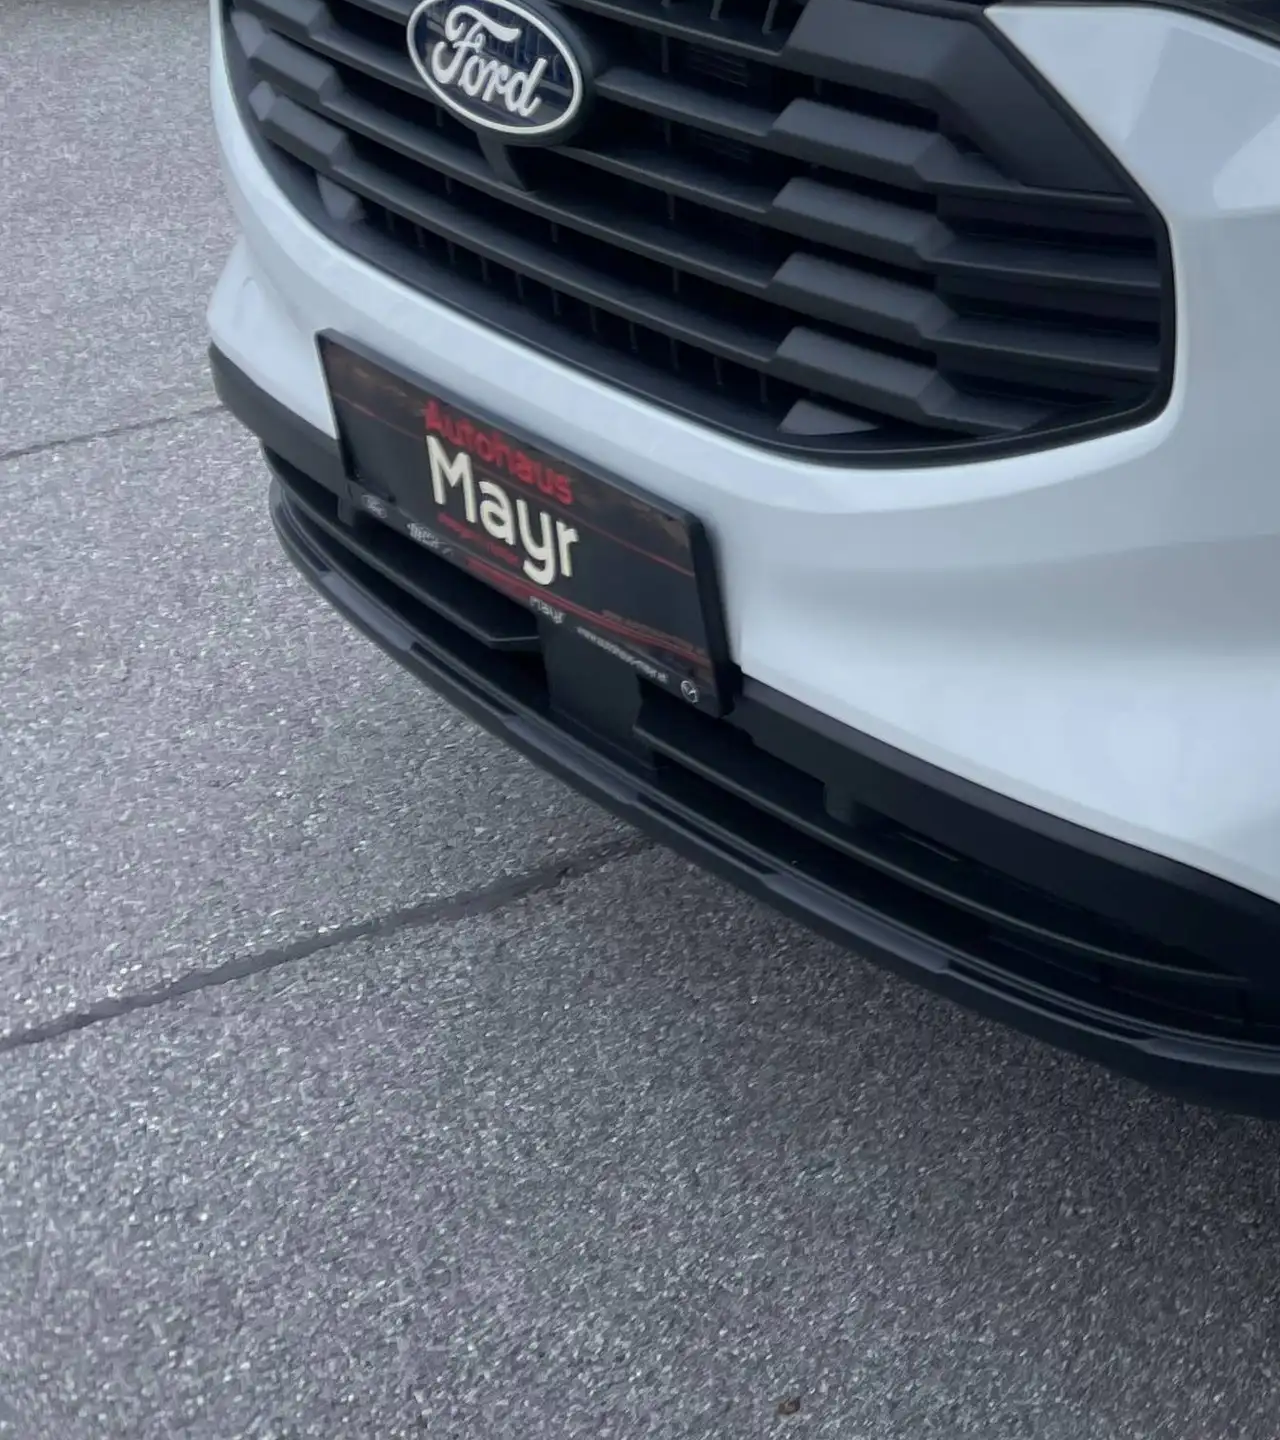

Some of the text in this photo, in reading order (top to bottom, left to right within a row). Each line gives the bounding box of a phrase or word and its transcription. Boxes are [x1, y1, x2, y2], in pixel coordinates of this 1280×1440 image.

[431, 4, 549, 117] Ford
[425, 400, 574, 505] Autohaus
[426, 434, 580, 585] Mayr
